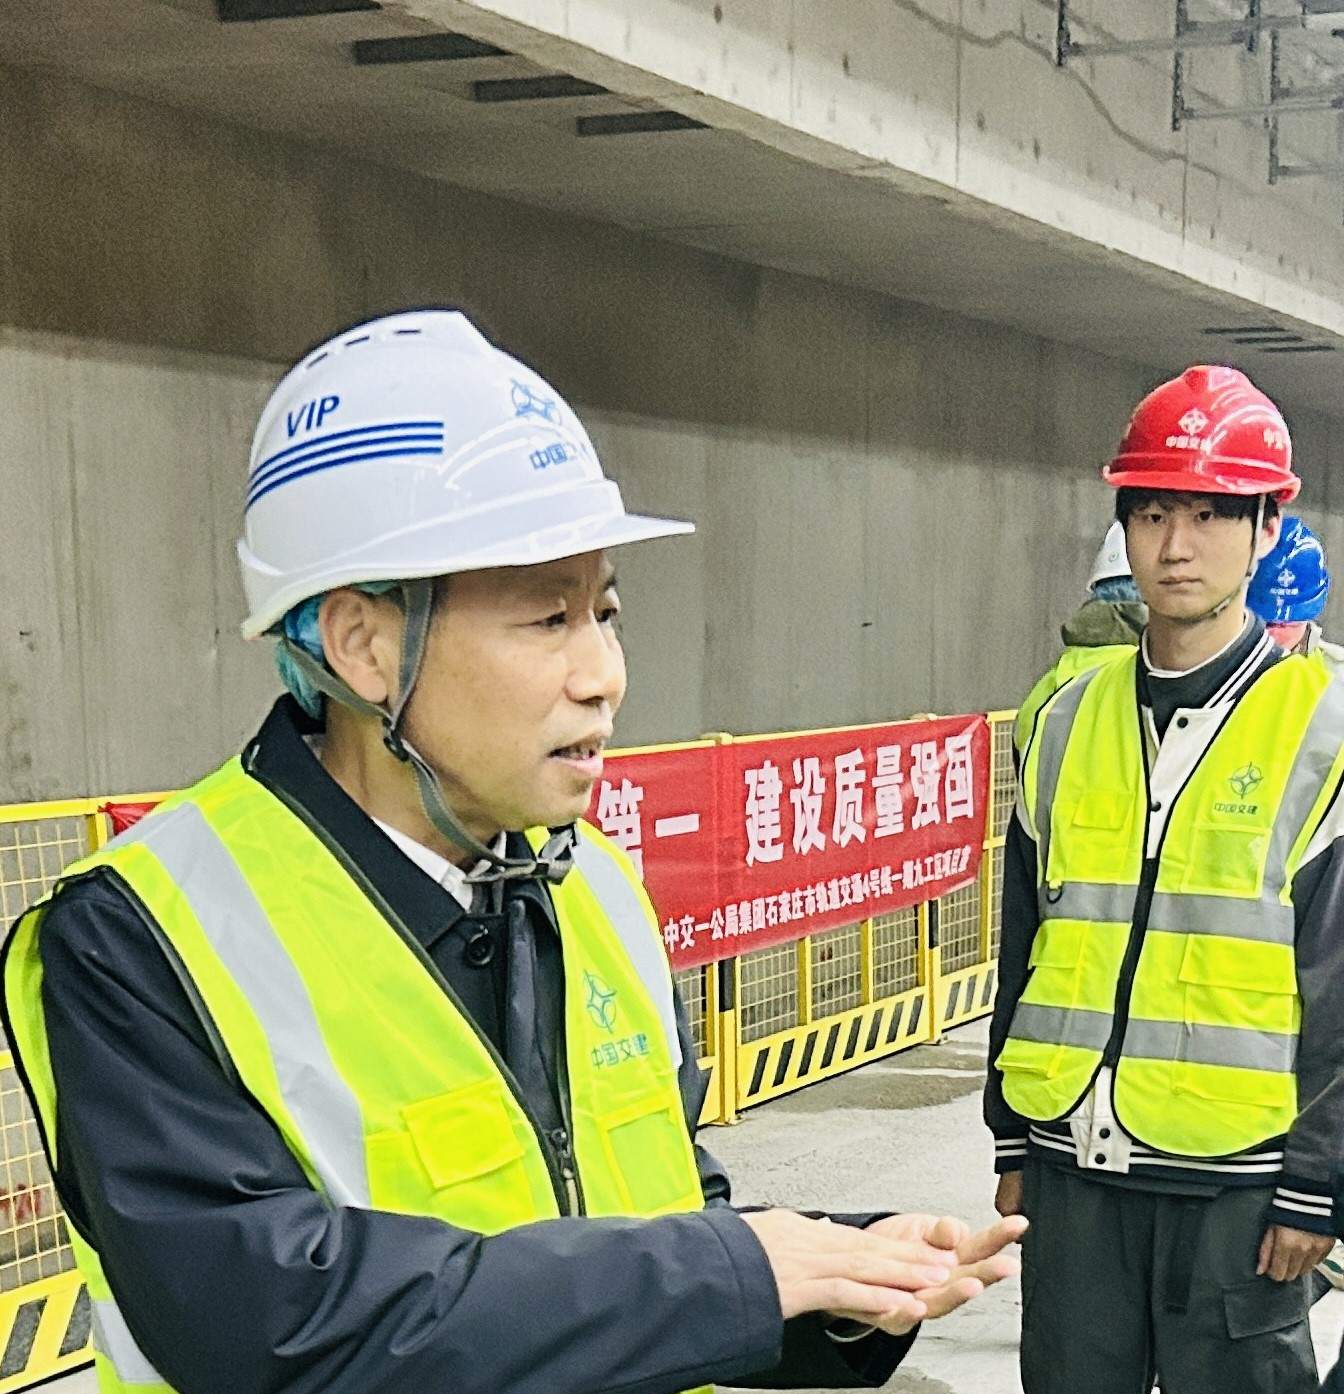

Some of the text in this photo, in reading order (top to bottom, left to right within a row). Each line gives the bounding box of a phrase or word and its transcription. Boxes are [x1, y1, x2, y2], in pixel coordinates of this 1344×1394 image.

[287, 395, 340, 439] VIP
[744, 732, 975, 867] 建设质量强国
[591, 1033, 650, 1070] 中国交建
